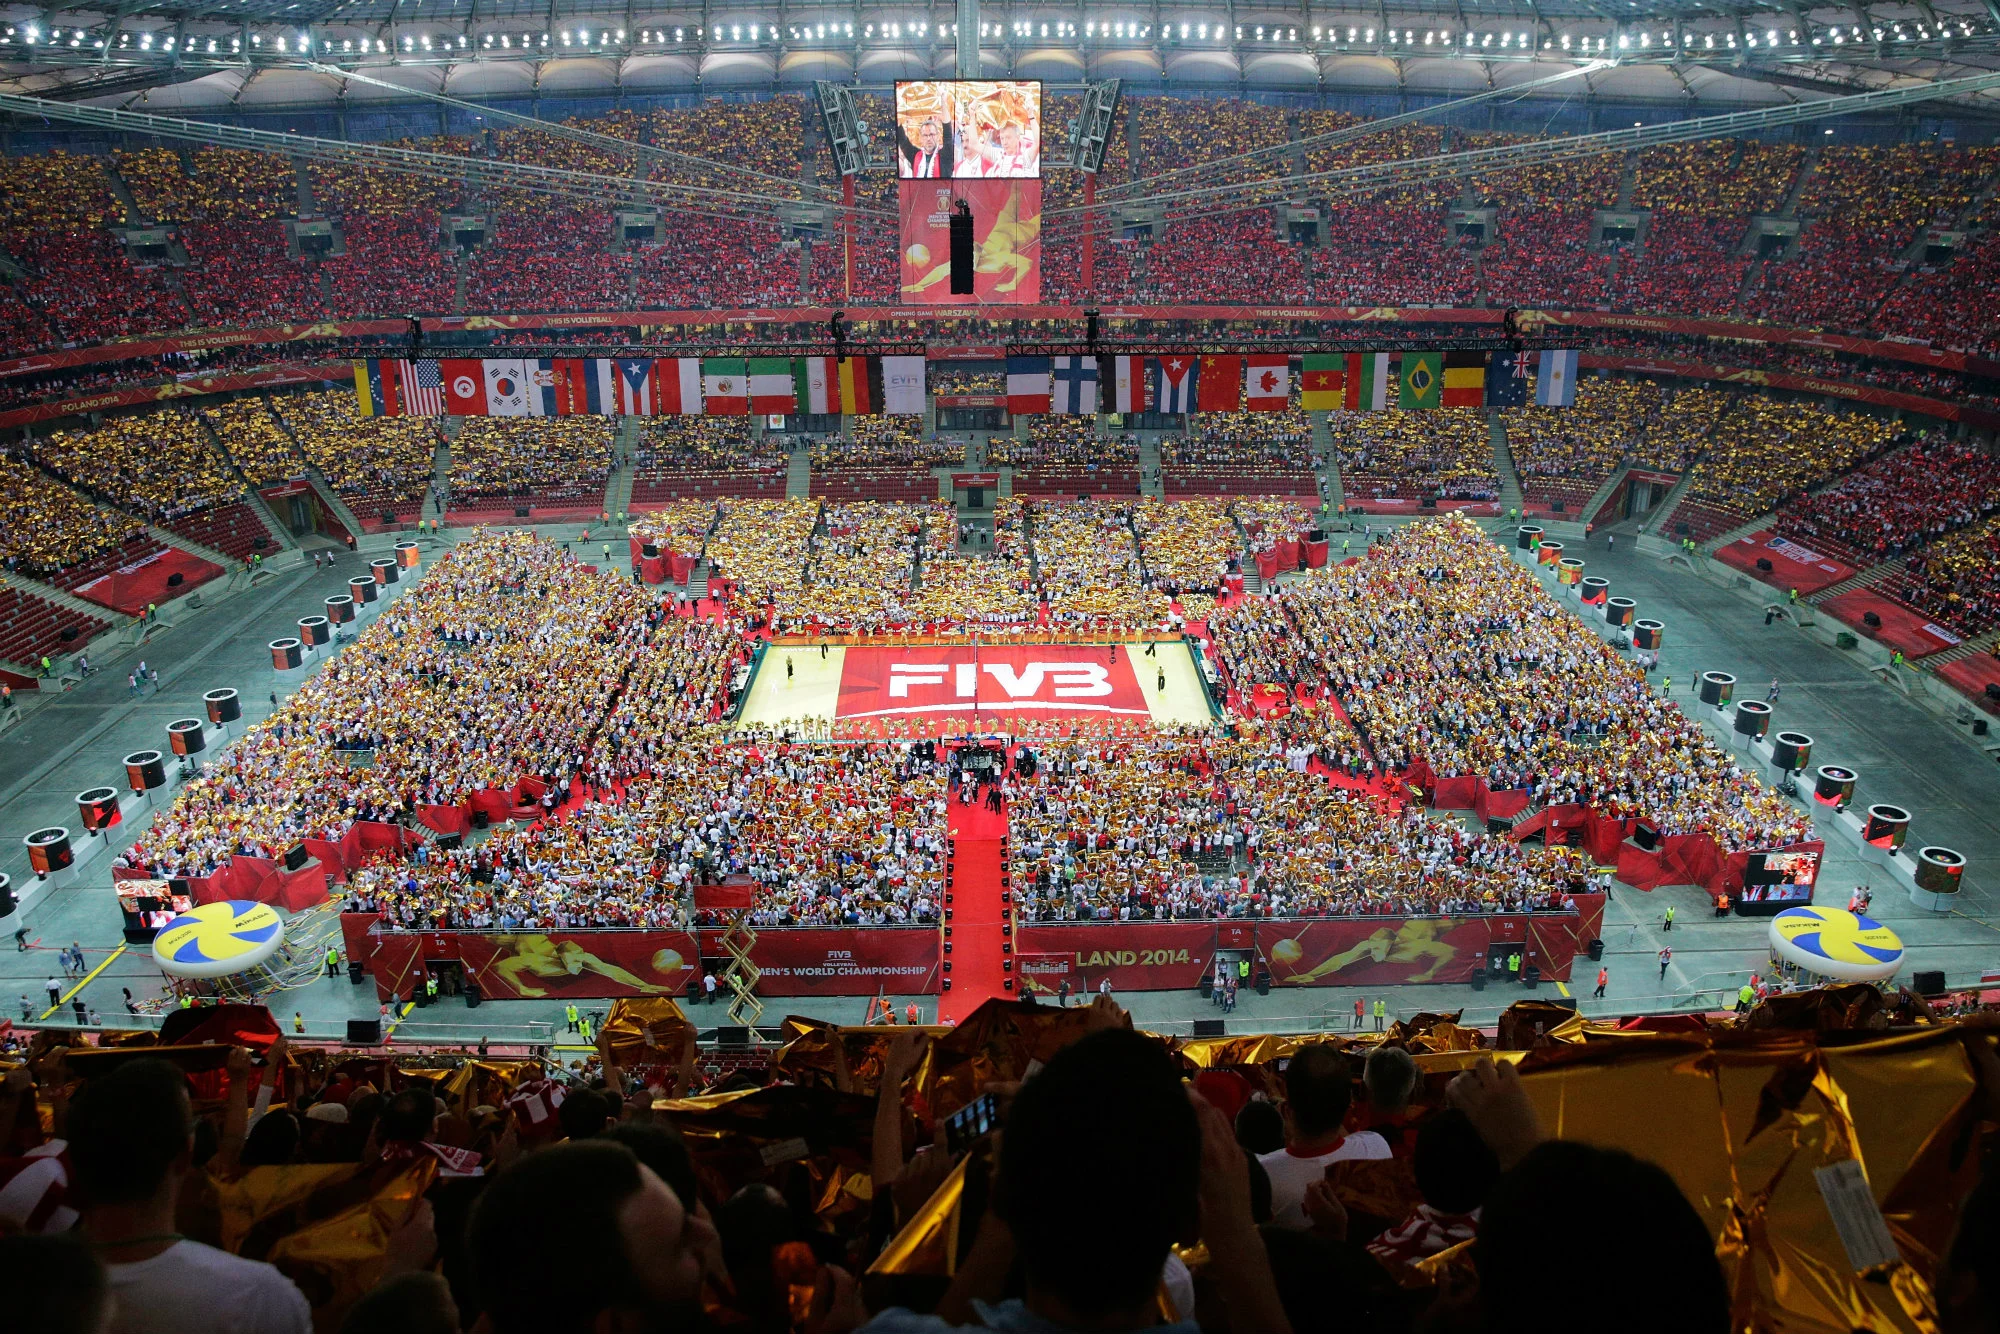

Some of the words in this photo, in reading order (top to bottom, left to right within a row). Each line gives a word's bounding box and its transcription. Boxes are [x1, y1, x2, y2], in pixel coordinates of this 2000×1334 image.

[934, 309, 980, 317] WARSZAWA
[1271, 309, 1278, 317] IS
[1279, 309, 1320, 317] VOLLEYBALL
[547, 317, 563, 325] THIS
[570, 316, 613, 324] VOLLEYBALL
[1600, 317, 1617, 325] THIS
[1624, 318, 1668, 329] VOLLEYBALL
[180, 339, 197, 348] THIS
[198, 338, 206, 346] IS
[205, 334, 252, 345] VOLLEYBALL
[1804, 380, 1839, 394] POLAND
[1839, 385, 1859, 397] 2014
[61, 399, 99, 412] POLAND
[99, 395, 120, 406] 2014
[889, 661, 1113, 698] FIVB
[827, 950, 852, 959] FIVB
[1075, 950, 1137, 967] LAND
[1140, 949, 1190, 966] 2014
[758, 967, 790, 976] MEN'S
[793, 967, 836, 976] WORLD
[837, 966, 927, 976] CHAMPIONSHIP
